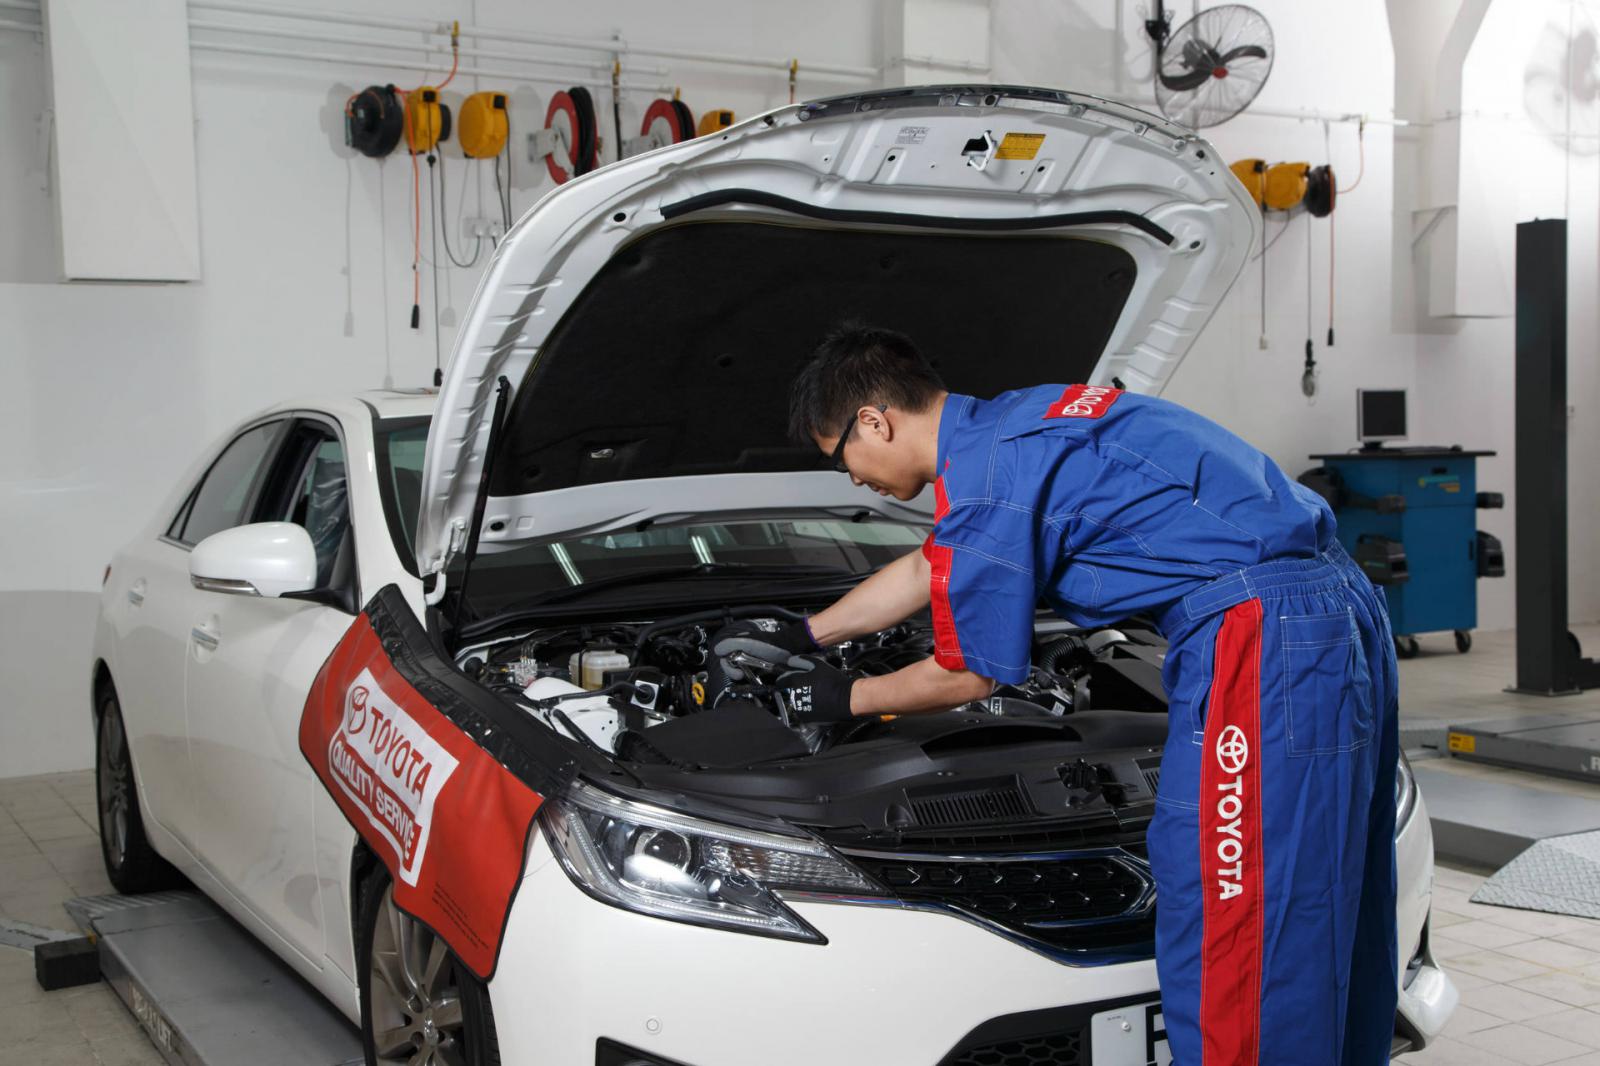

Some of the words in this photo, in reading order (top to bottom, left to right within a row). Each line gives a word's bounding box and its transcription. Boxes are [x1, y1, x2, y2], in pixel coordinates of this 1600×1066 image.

[1074, 386, 1110, 405] TOYO
[332, 740, 375, 803] QUALITY
[369, 706, 432, 805] TOYOTA
[1217, 775, 1243, 900] TOYOTA
